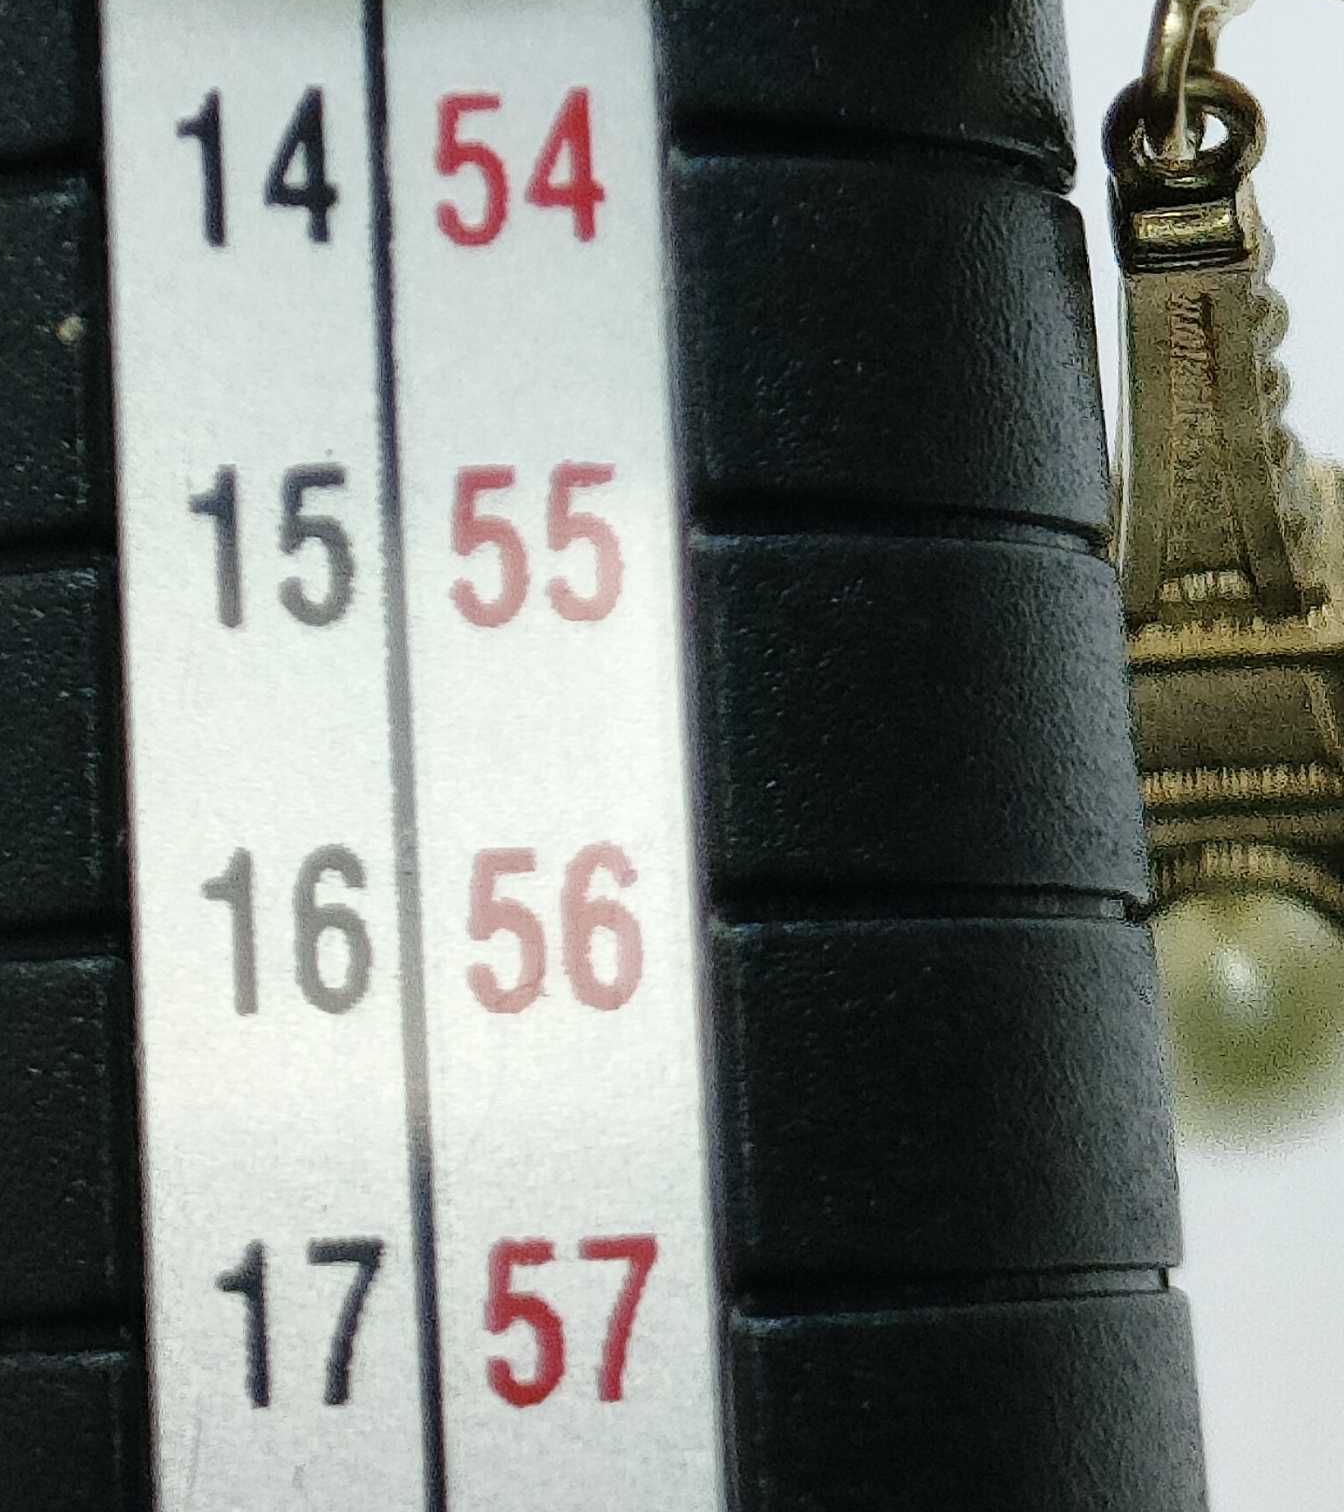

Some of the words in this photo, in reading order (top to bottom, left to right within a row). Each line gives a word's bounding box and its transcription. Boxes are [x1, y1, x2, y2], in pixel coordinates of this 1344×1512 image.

[179, 89, 338, 246] 14
[439, 89, 604, 246] 54
[189, 462, 356, 629] 15
[451, 462, 622, 628] 55
[200, 843, 370, 1015] 16
[468, 842, 641, 1014] 56
[217, 1237, 384, 1407] 17
[486, 1234, 659, 1407] 57
